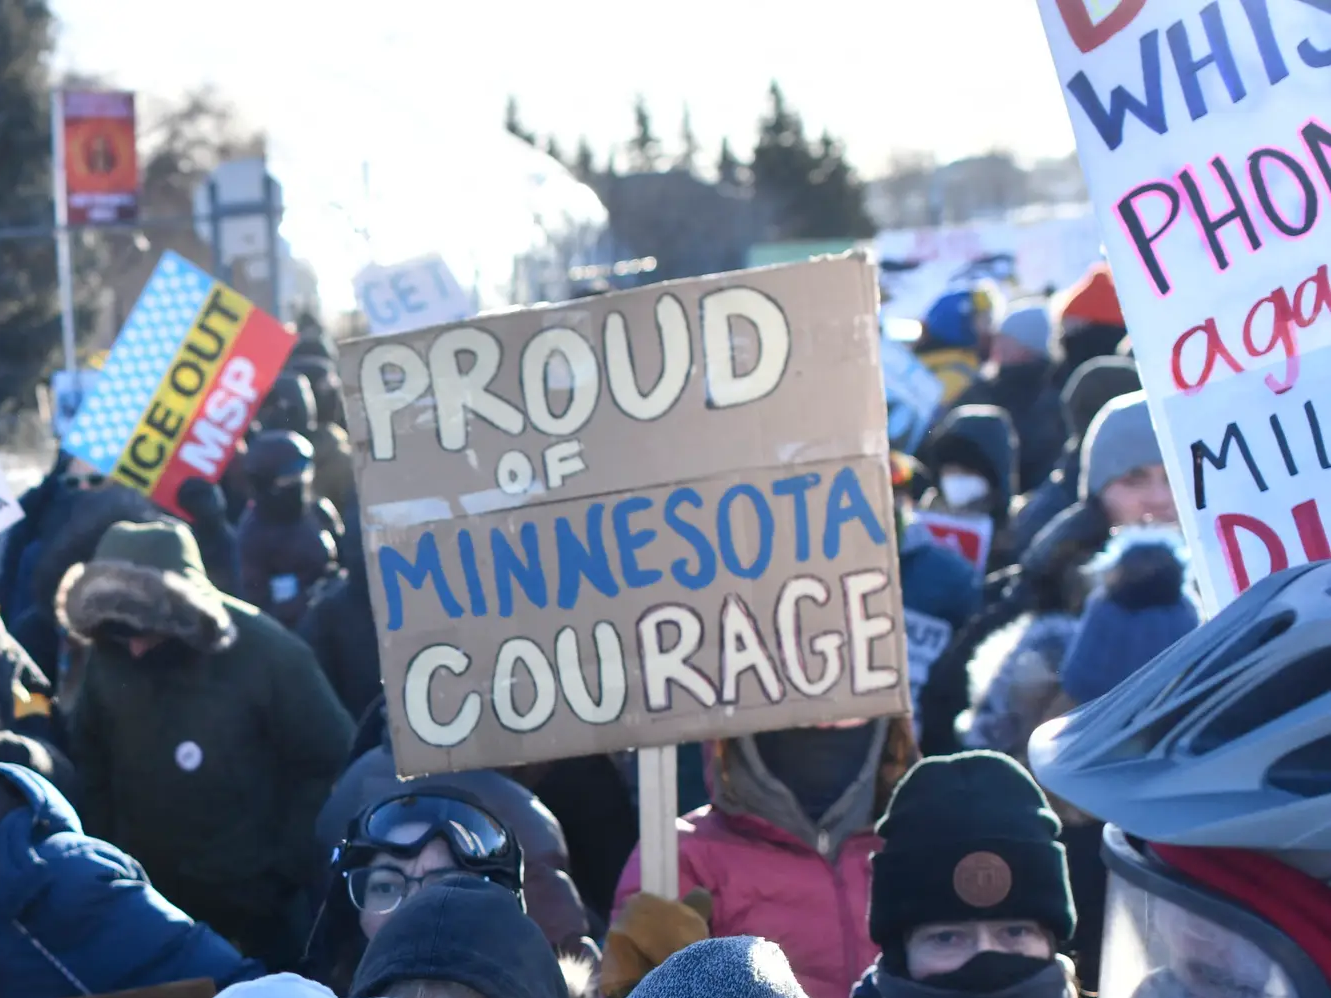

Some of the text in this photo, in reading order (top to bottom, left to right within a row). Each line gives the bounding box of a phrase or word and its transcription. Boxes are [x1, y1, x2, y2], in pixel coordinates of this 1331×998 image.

[1067, 0, 1331, 151] WHI
[118, 289, 243, 488] ICE OUT
[179, 356, 257, 476] MSP
[360, 285, 791, 462] PROUD
[378, 466, 888, 631] MINNESOTA
[495, 440, 586, 496] OF
[404, 568, 899, 748] COURAGE
